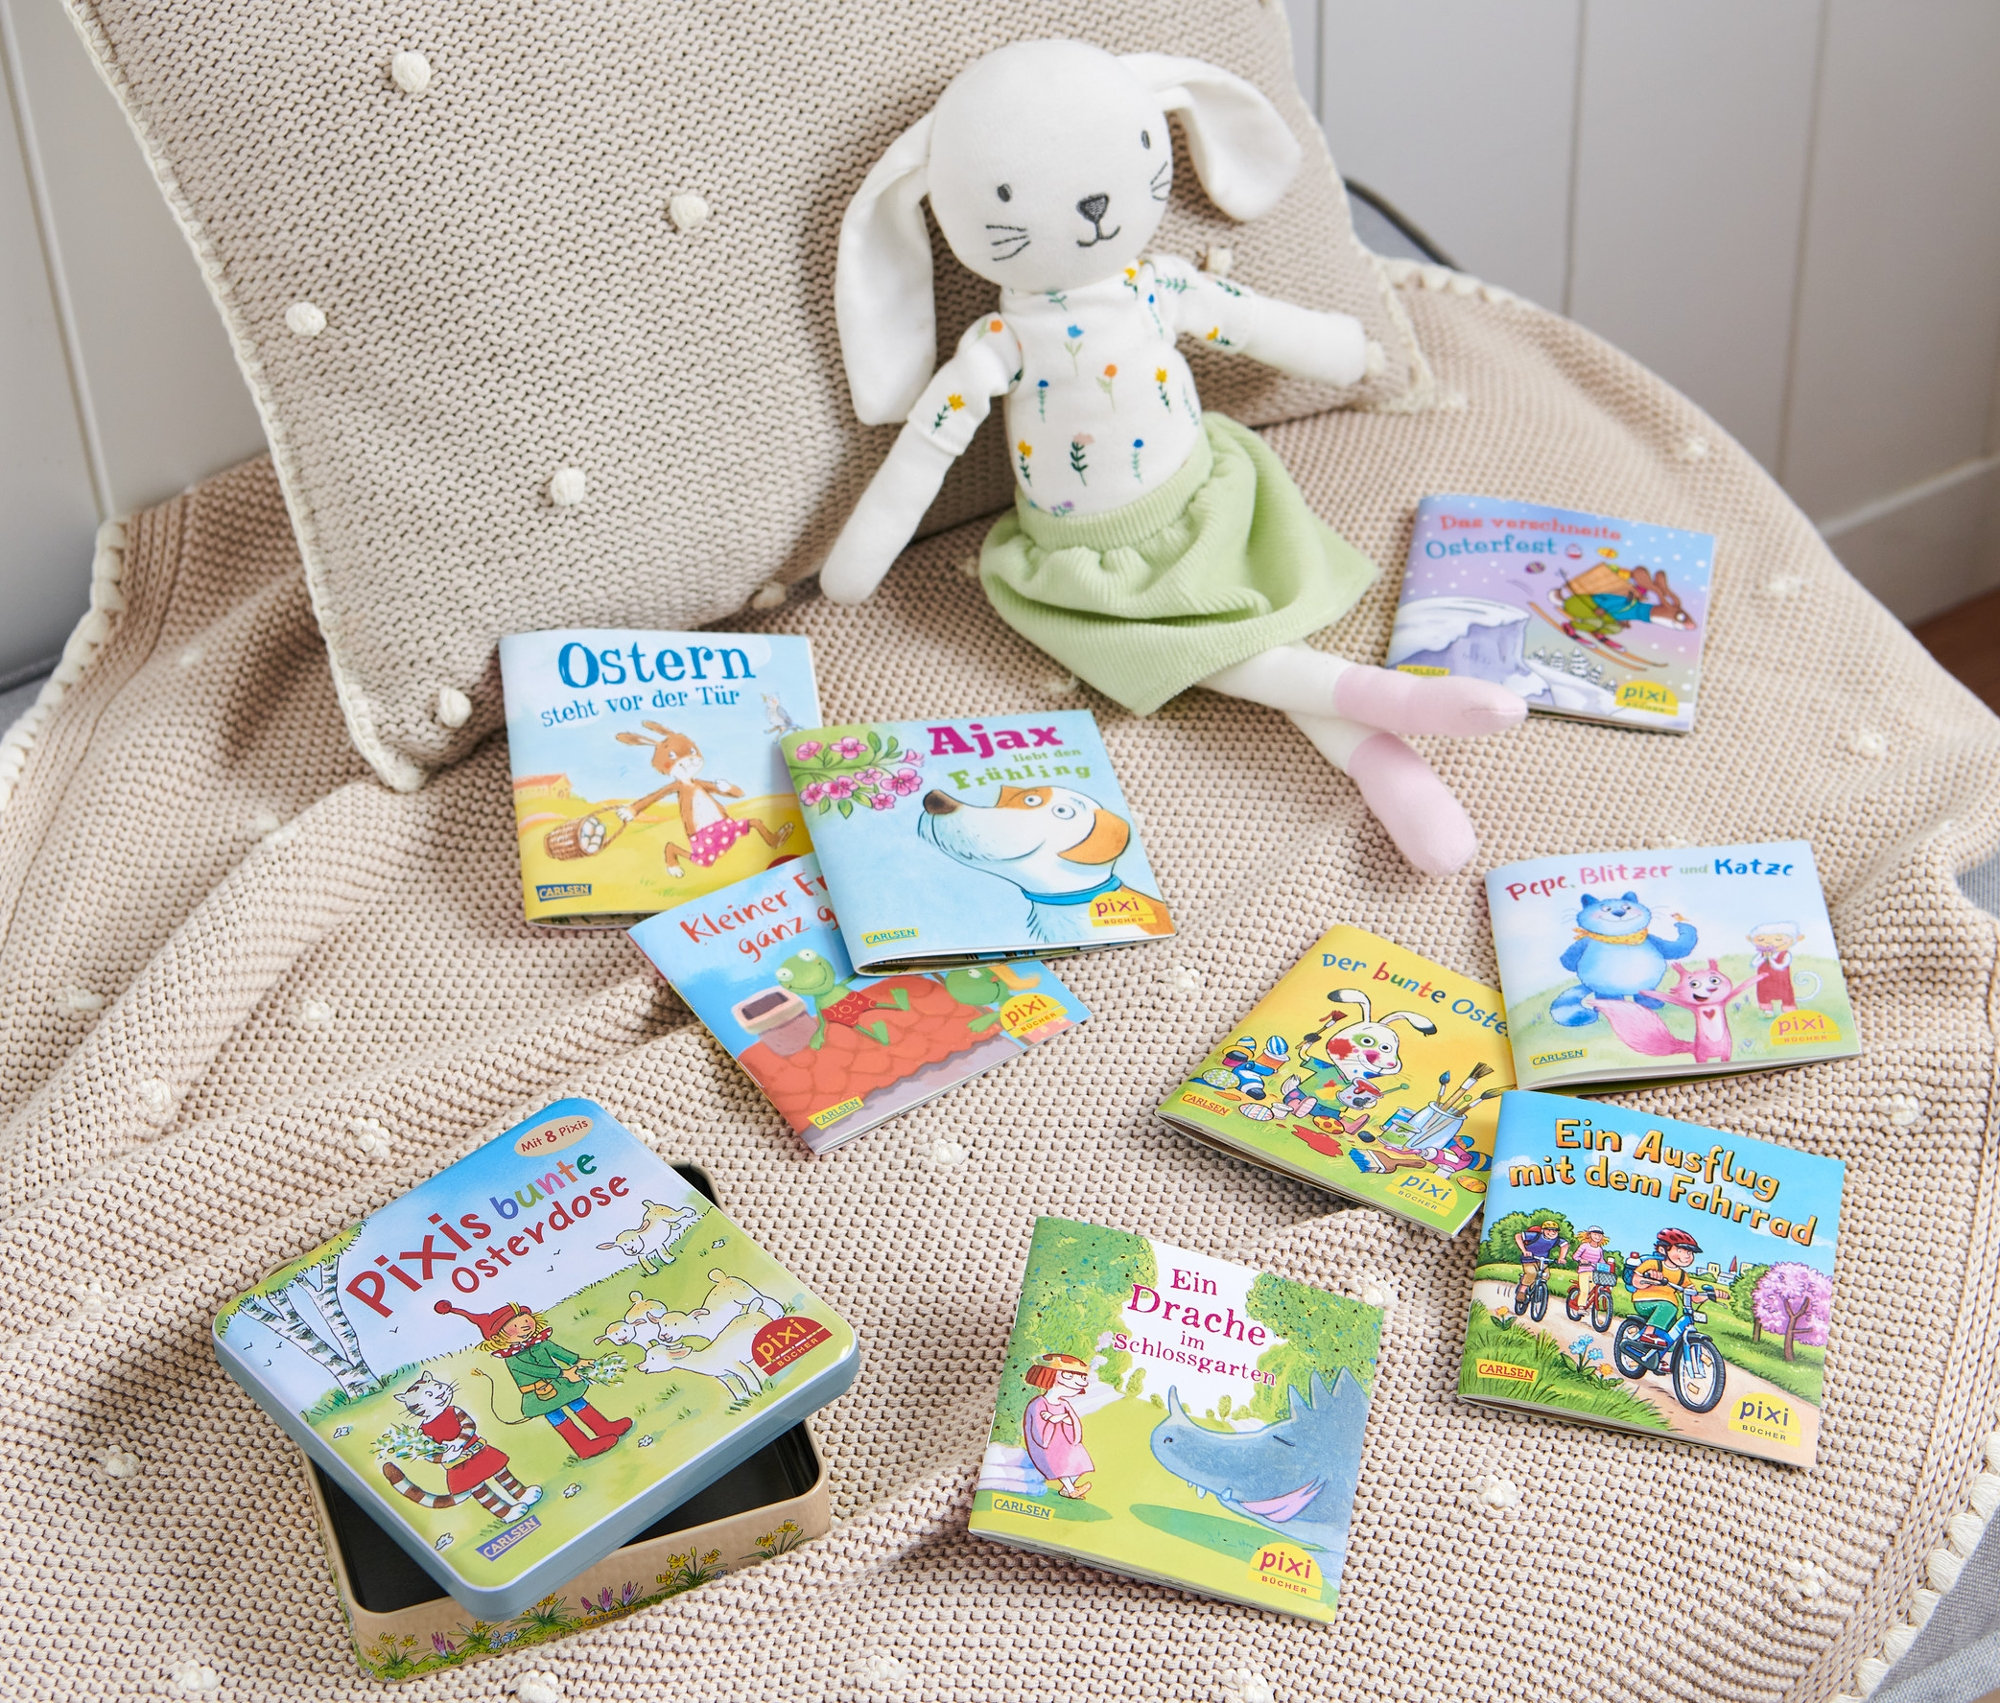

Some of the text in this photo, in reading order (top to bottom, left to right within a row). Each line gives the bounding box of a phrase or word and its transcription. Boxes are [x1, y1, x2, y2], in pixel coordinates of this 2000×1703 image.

[1440, 515, 1621, 541] Das verschneite
[1425, 533, 1557, 559] Osterfest
[557, 641, 756, 689] Ostern
[540, 685, 740, 728] steht vor der Tür
[1623, 685, 1668, 703] pixi
[926, 723, 1064, 760] Ajax
[1012, 749, 1082, 763] liebt den
[947, 764, 1091, 790] Frühling
[1580, 864, 1673, 885] Blitzer
[1680, 864, 1709, 875] und
[1714, 858, 1794, 876] Katze
[537, 884, 591, 900] CARLSEN
[679, 889, 788, 944] Kleiner
[1095, 897, 1139, 917] pixi
[738, 916, 811, 963] ganz
[864, 929, 917, 946] CARLSEN
[1321, 953, 1508, 1038] Der bunte Oste
[1004, 995, 1047, 1027] pixi
[1020, 1012, 1056, 1032] BÜCHER
[1778, 1014, 1824, 1036] pixi
[1531, 1048, 1585, 1067] CARLSEN
[813, 1102, 861, 1127] CARLSEN
[1182, 1094, 1230, 1117] CARLSEN
[521, 1120, 589, 1152] Mit 8 Pixis
[1555, 1118, 1780, 1202] Ein Ausflug
[1397, 1190, 1438, 1210] BÜCHER
[1400, 1175, 1452, 1201] pixi
[1509, 1155, 1818, 1247] mit dem Fahrrad
[345, 1153, 598, 1318] Pixis bunte
[451, 1175, 630, 1294] Osterdose
[1170, 1268, 1218, 1296] Ein
[1127, 1284, 1267, 1346] Drache
[756, 1318, 807, 1362] pixi
[777, 1337, 819, 1367] BÜCHER
[1180, 1331, 1205, 1350] im
[1114, 1333, 1276, 1387] Schlossgarten
[1478, 1363, 1534, 1381] CARLSEN
[1739, 1400, 1789, 1427] pixi
[1742, 1424, 1786, 1441] BÜCHER
[993, 1498, 1051, 1520] CARLSEN
[483, 1517, 540, 1558] CARLSEN
[1259, 1551, 1311, 1579] pixi
[1261, 1575, 1307, 1594] BÜCHER
[584, 1607, 633, 1626] CARLSEN
